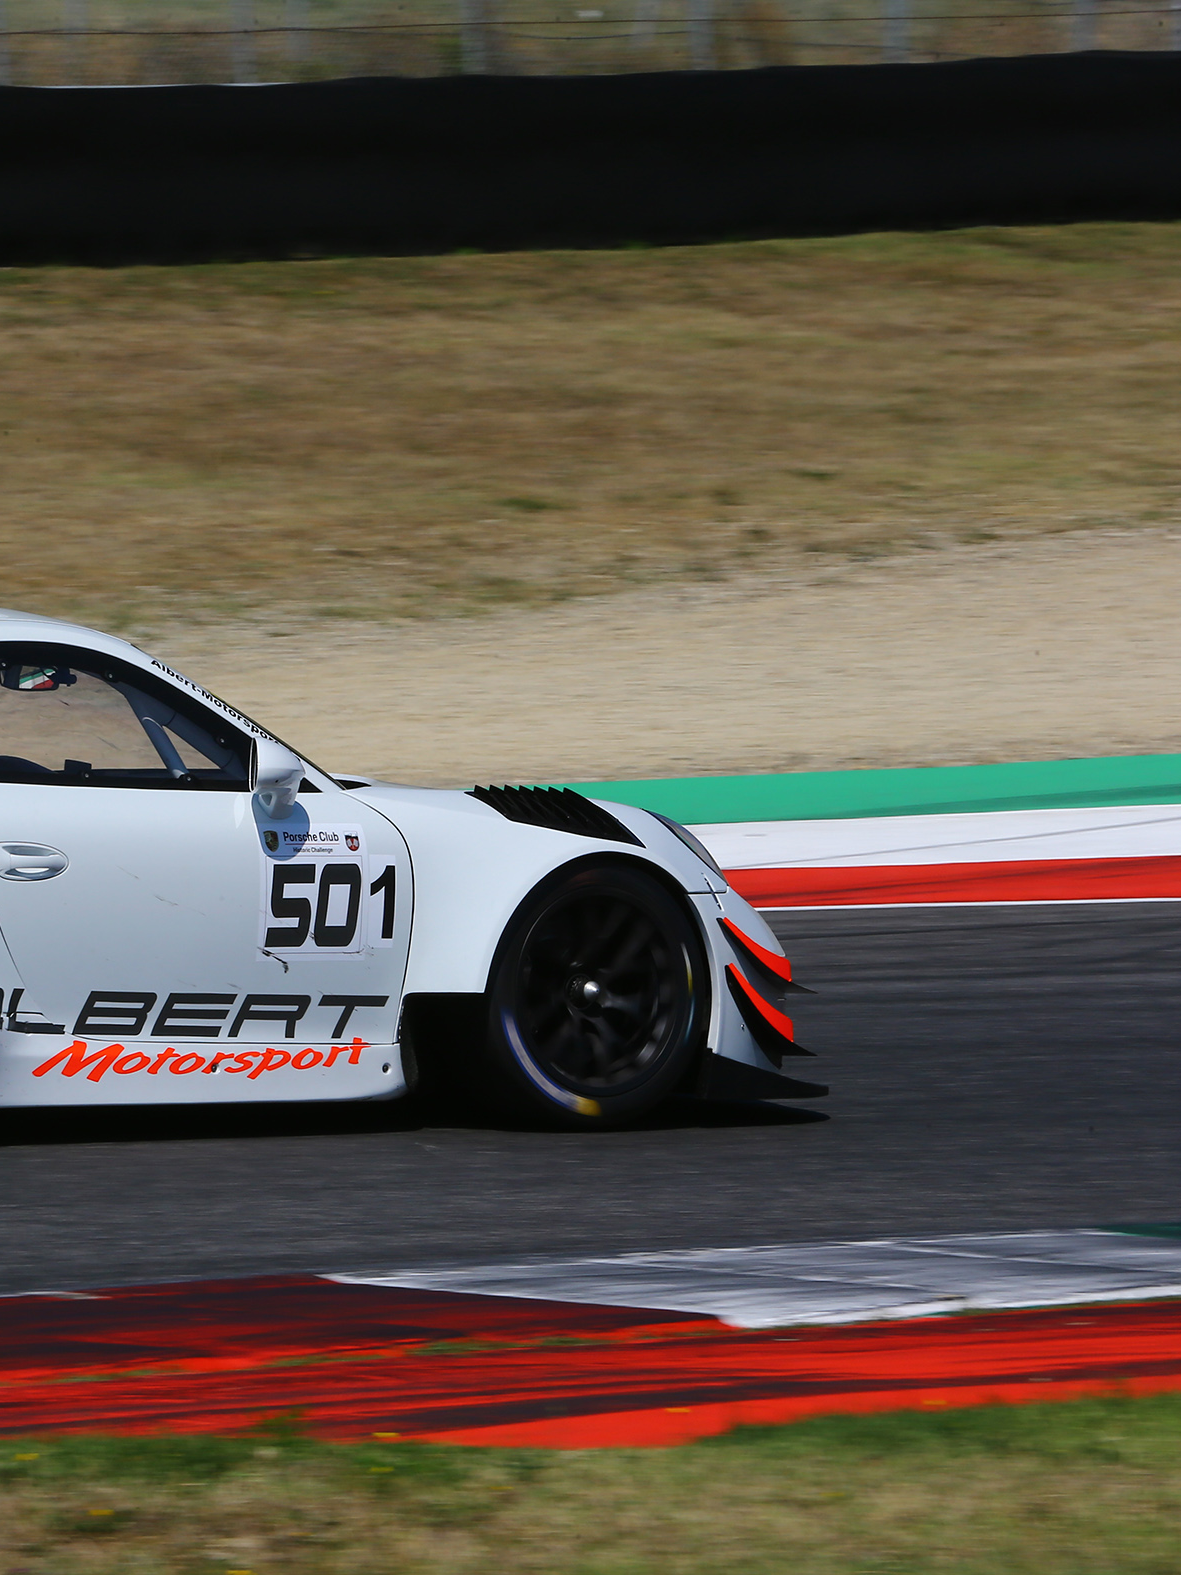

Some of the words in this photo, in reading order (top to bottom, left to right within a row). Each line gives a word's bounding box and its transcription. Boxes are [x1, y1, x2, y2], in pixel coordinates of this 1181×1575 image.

[283, 832, 317, 842] Porsche
[319, 832, 339, 842] Club
[265, 864, 396, 947] 501
[32, 1037, 369, 1082] Motorsport
